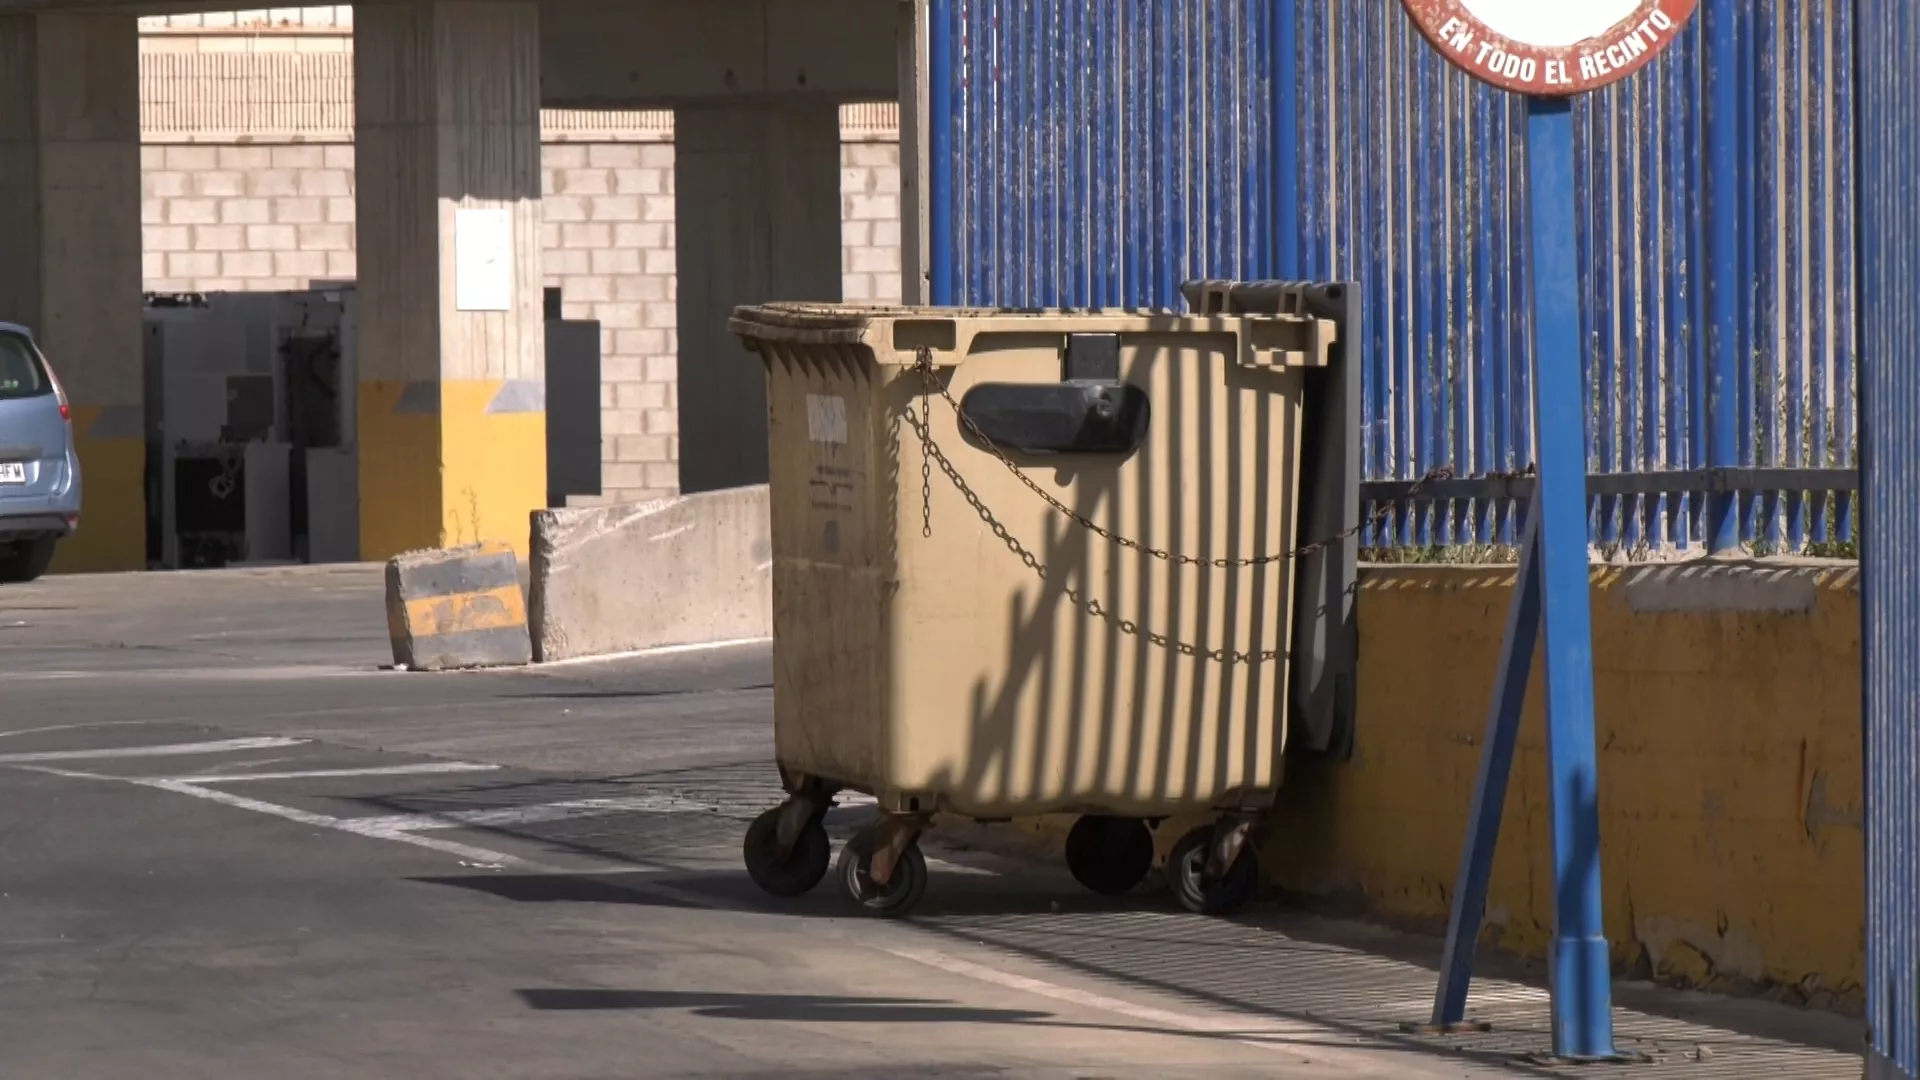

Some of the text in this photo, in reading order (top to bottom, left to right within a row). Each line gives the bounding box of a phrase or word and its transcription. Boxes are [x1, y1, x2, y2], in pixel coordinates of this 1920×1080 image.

[1438, 9, 1671, 84] EN TODO EL RECINTO
